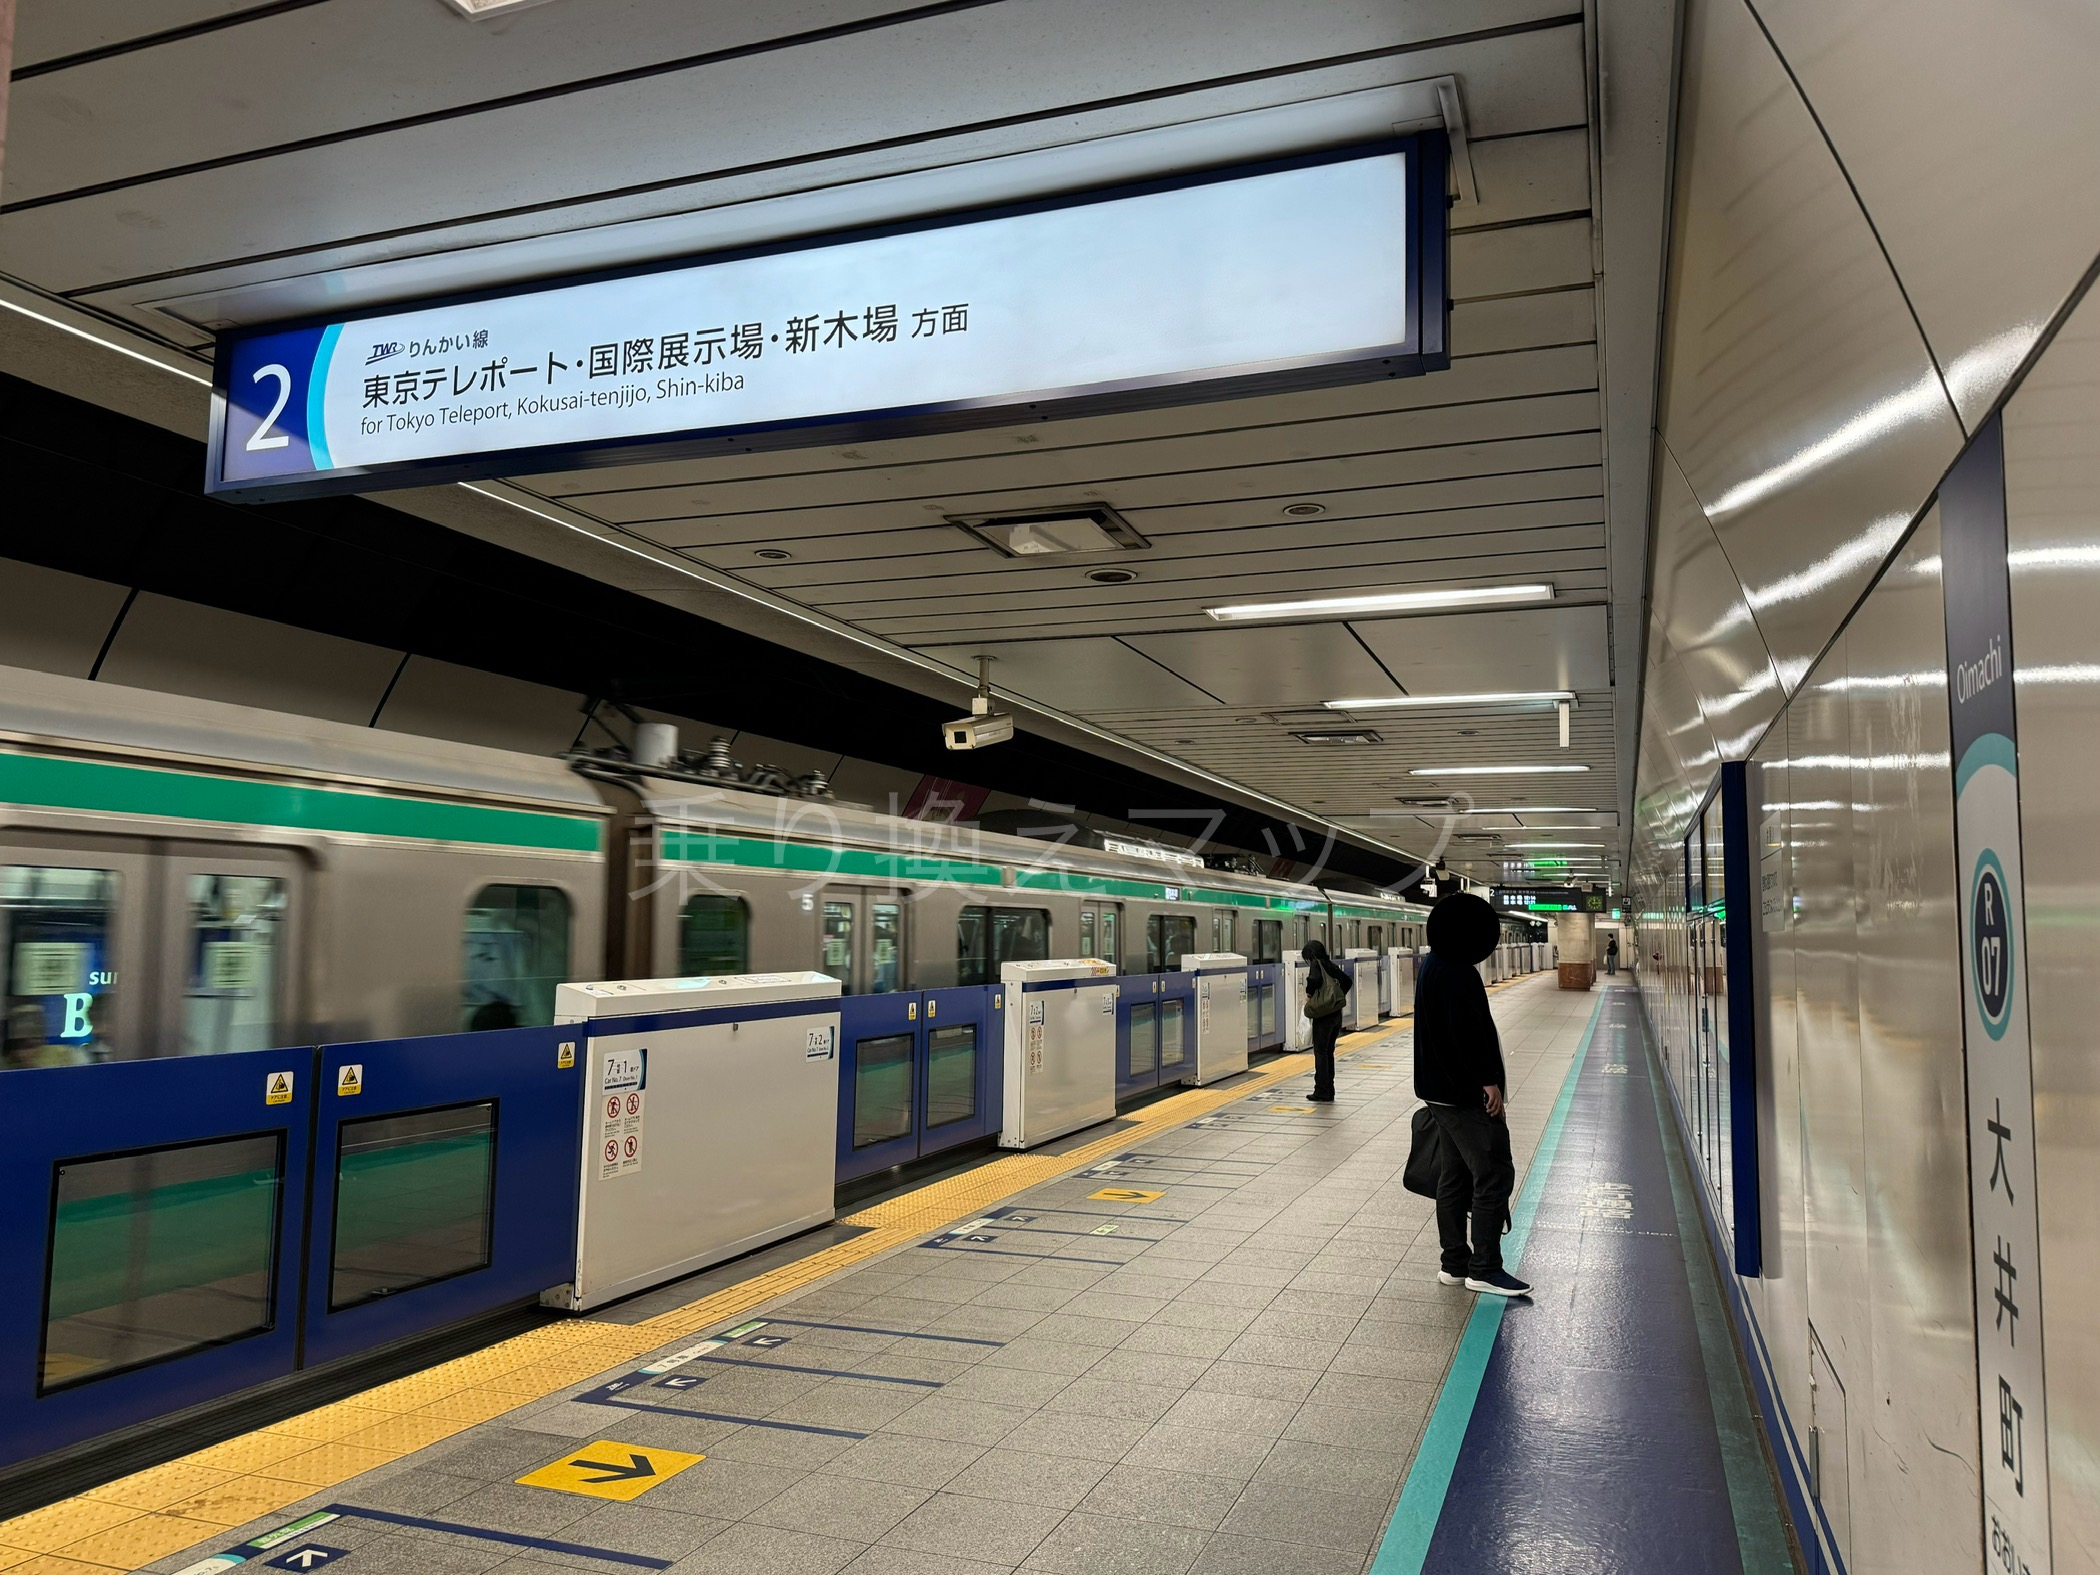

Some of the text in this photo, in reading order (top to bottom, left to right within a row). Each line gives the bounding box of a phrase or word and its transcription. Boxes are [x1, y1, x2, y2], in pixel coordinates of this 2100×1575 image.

[362, 302, 970, 409] 東京テレポート・国際展示場・新木場 方面
[408, 328, 490, 358] りんかい線
[245, 362, 292, 452] 2
[360, 371, 745, 435] for Tokyo Teleport, Kokusai-tenjijo, Shin-kiba
[1956, 634, 2002, 704] Oimachi
[801, 893, 814, 911] 5
[1984, 882, 1994, 926] R
[1981, 936, 2000, 996] 07
[1986, 1096, 2025, 1499] 大井町
